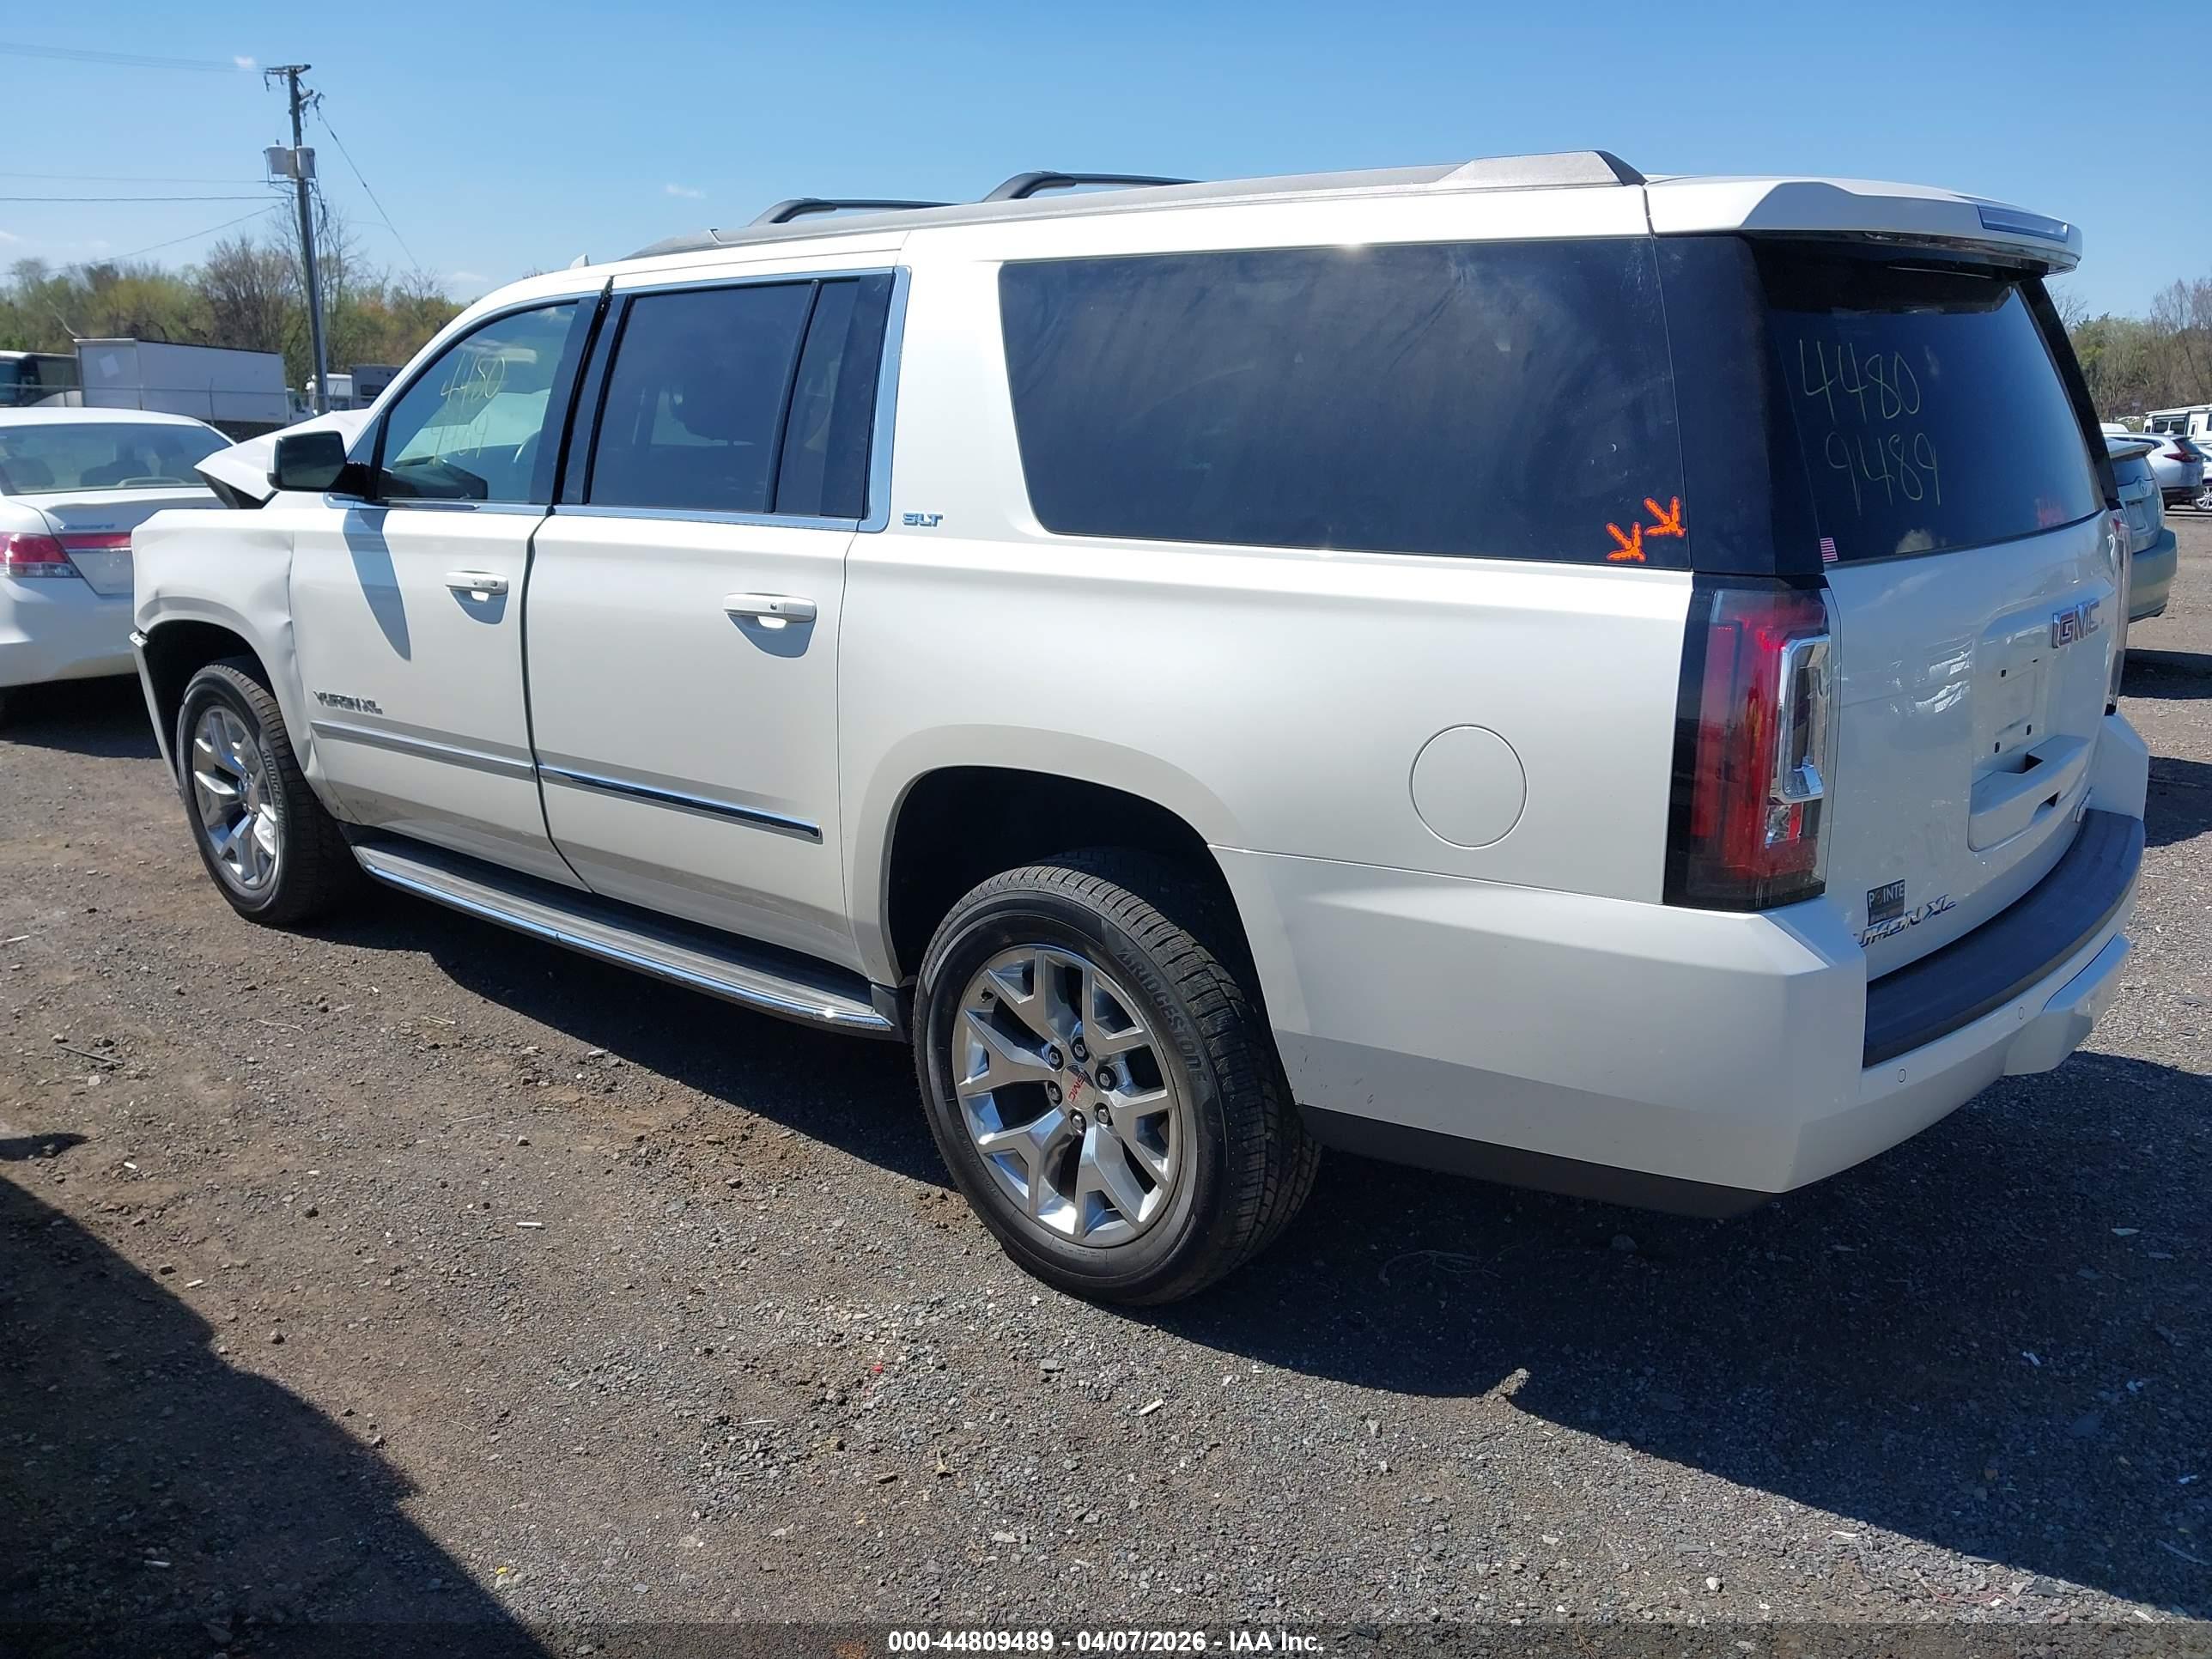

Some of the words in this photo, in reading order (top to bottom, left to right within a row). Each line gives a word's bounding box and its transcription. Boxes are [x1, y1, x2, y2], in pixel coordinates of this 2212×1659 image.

[1799, 338, 1921, 424] 4480
[1826, 431, 1941, 516] 9489
[902, 513, 944, 527] SLT
[2051, 599, 2100, 649] GMC
[361, 698, 383, 714] XL
[1868, 881, 1905, 908] POINTE
[1067, 1072, 1086, 1103] GMC
